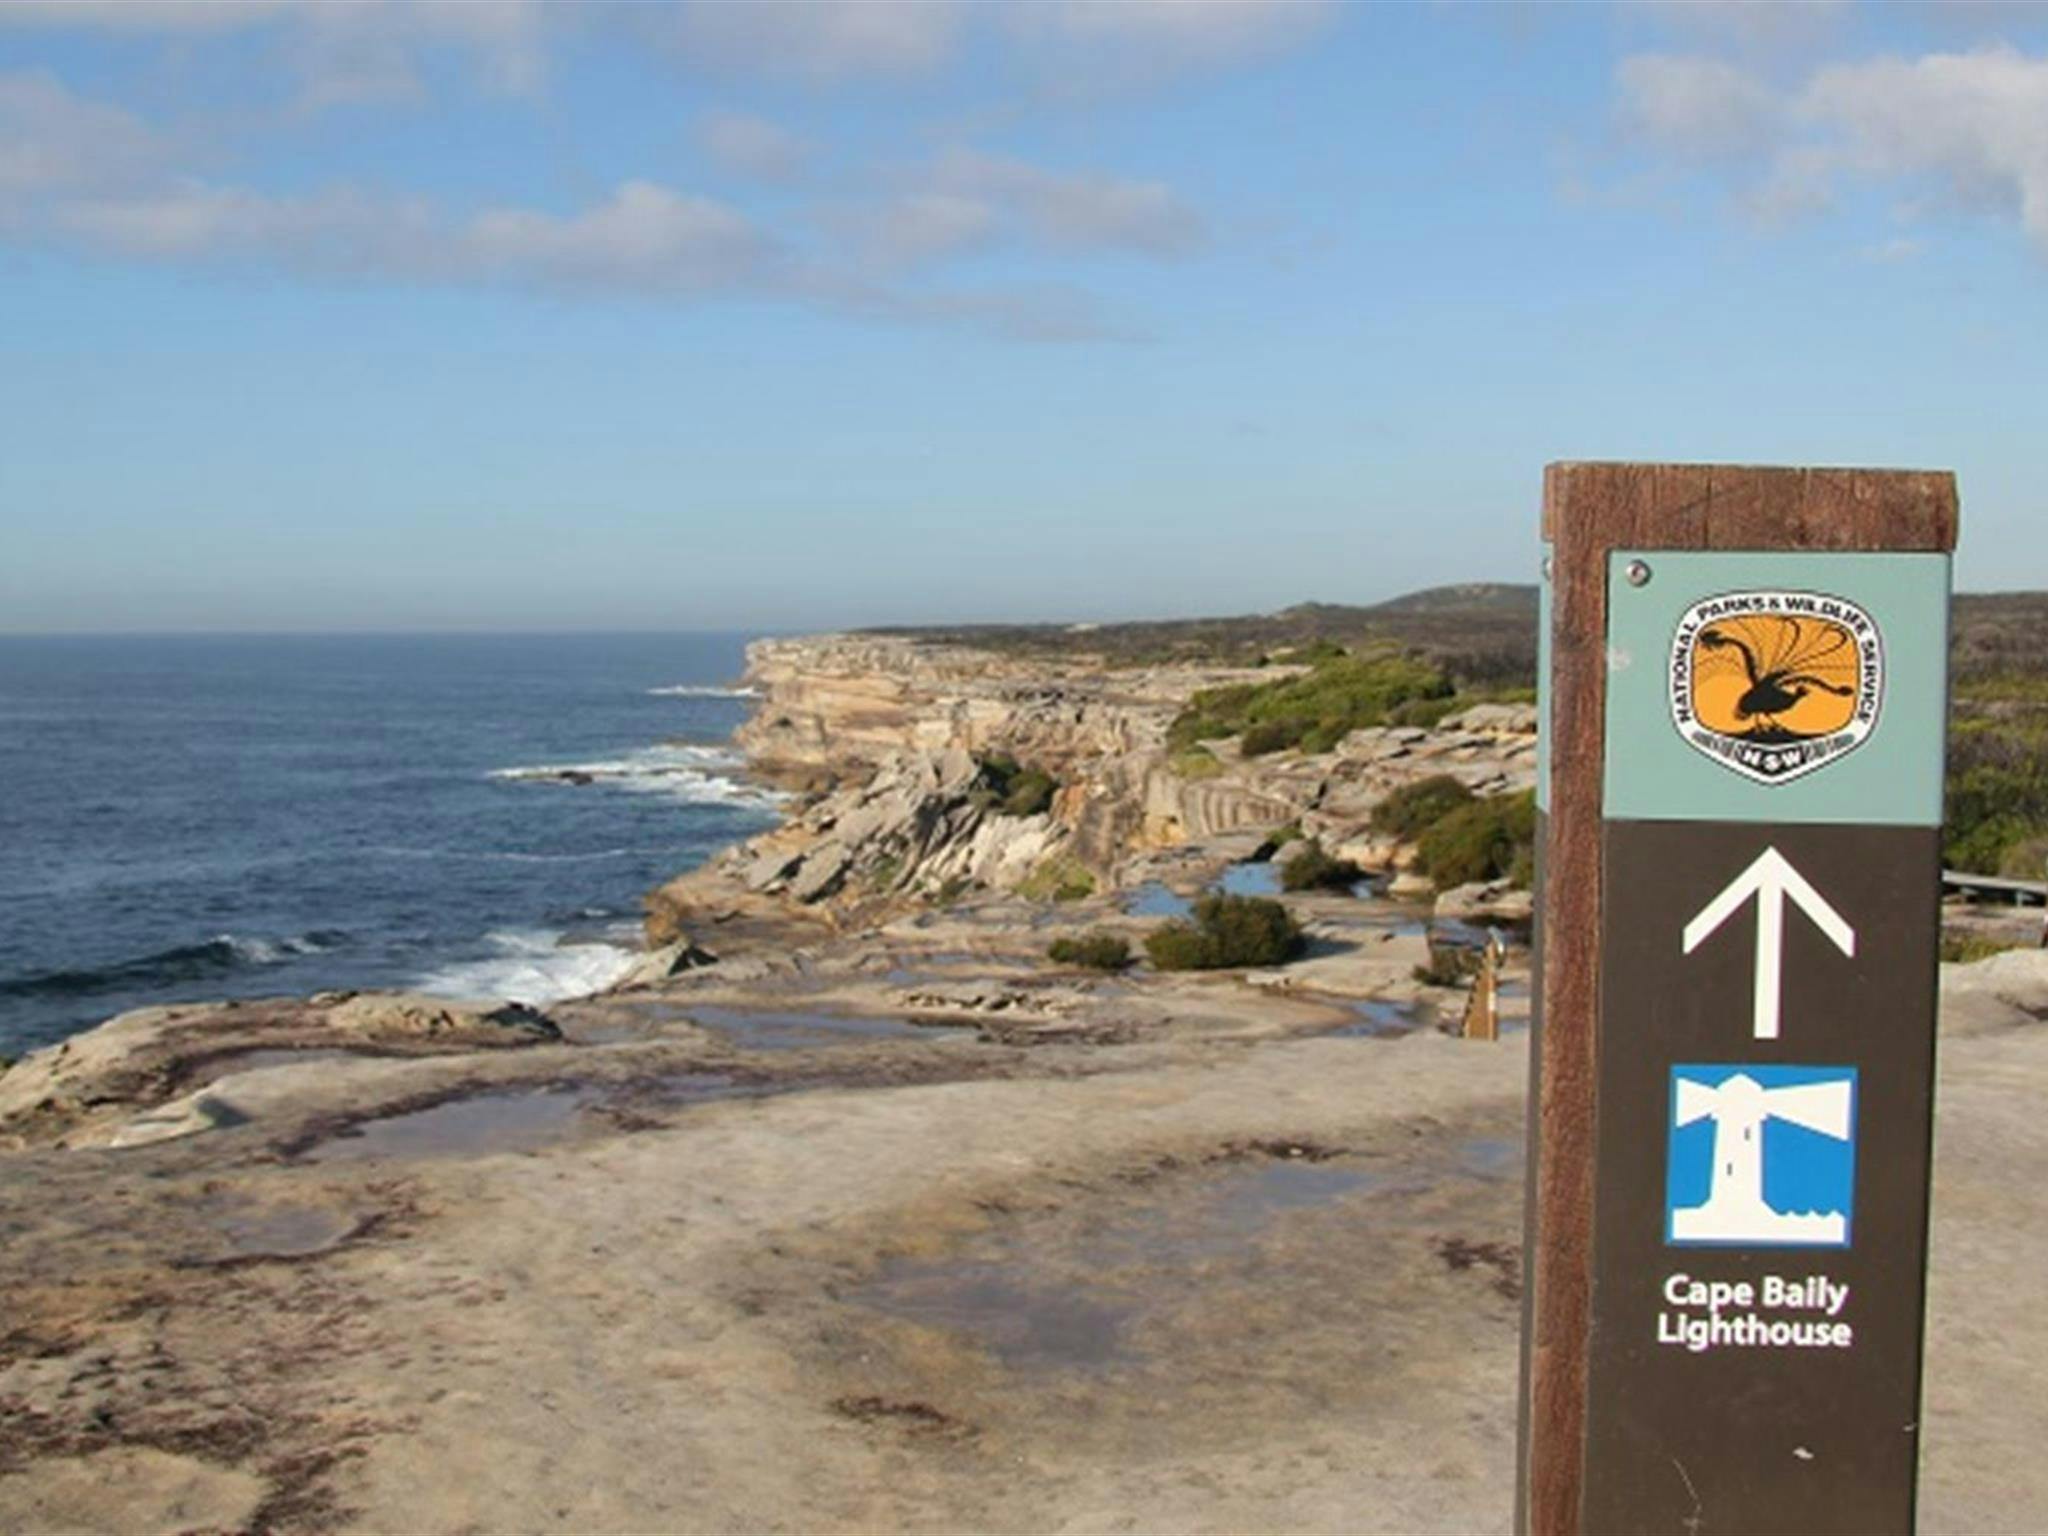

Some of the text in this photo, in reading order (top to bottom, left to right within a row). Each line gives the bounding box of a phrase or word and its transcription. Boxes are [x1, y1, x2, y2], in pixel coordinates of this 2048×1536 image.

[1673, 622, 1698, 723] NATIONAL
[1697, 596, 1765, 621] PARKS
[1785, 596, 1871, 638] WILDLIFE
[1857, 639, 1877, 725] SERVICE
[1743, 746, 1805, 771] NSW
[1665, 1273, 1849, 1315] Cape Baily
[1658, 1312, 1853, 1352] Lighthouse
